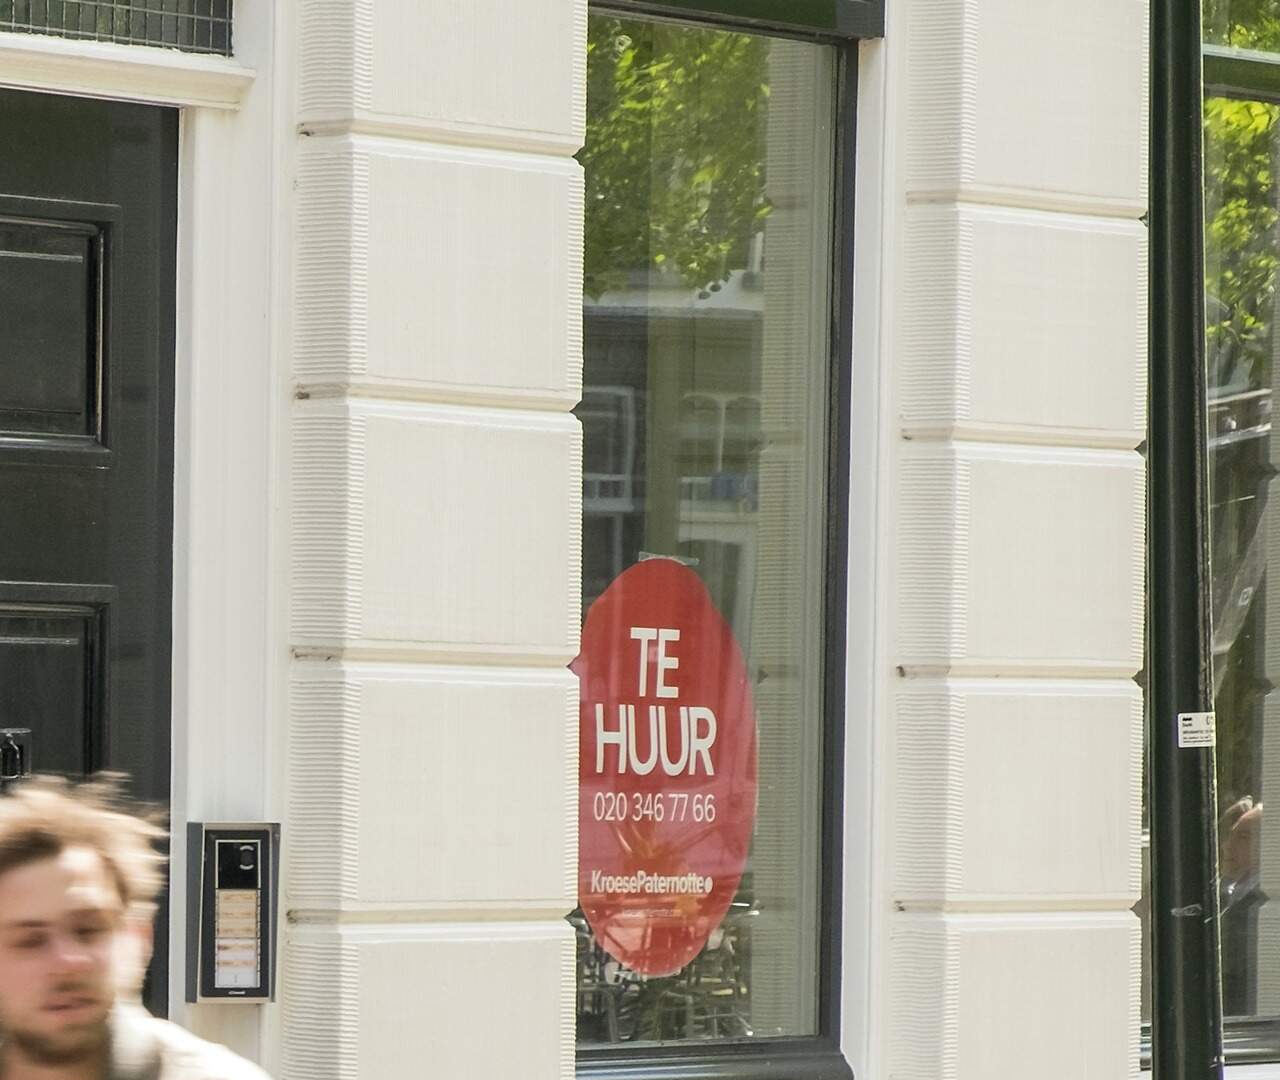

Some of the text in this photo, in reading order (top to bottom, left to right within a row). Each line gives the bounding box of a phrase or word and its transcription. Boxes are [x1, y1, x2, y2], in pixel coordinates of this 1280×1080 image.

[630, 626, 681, 699] TE
[595, 703, 717, 777] HUUR
[593, 791, 716, 823] 020 346 77 66
[591, 869, 705, 896] KroesePaternotte
